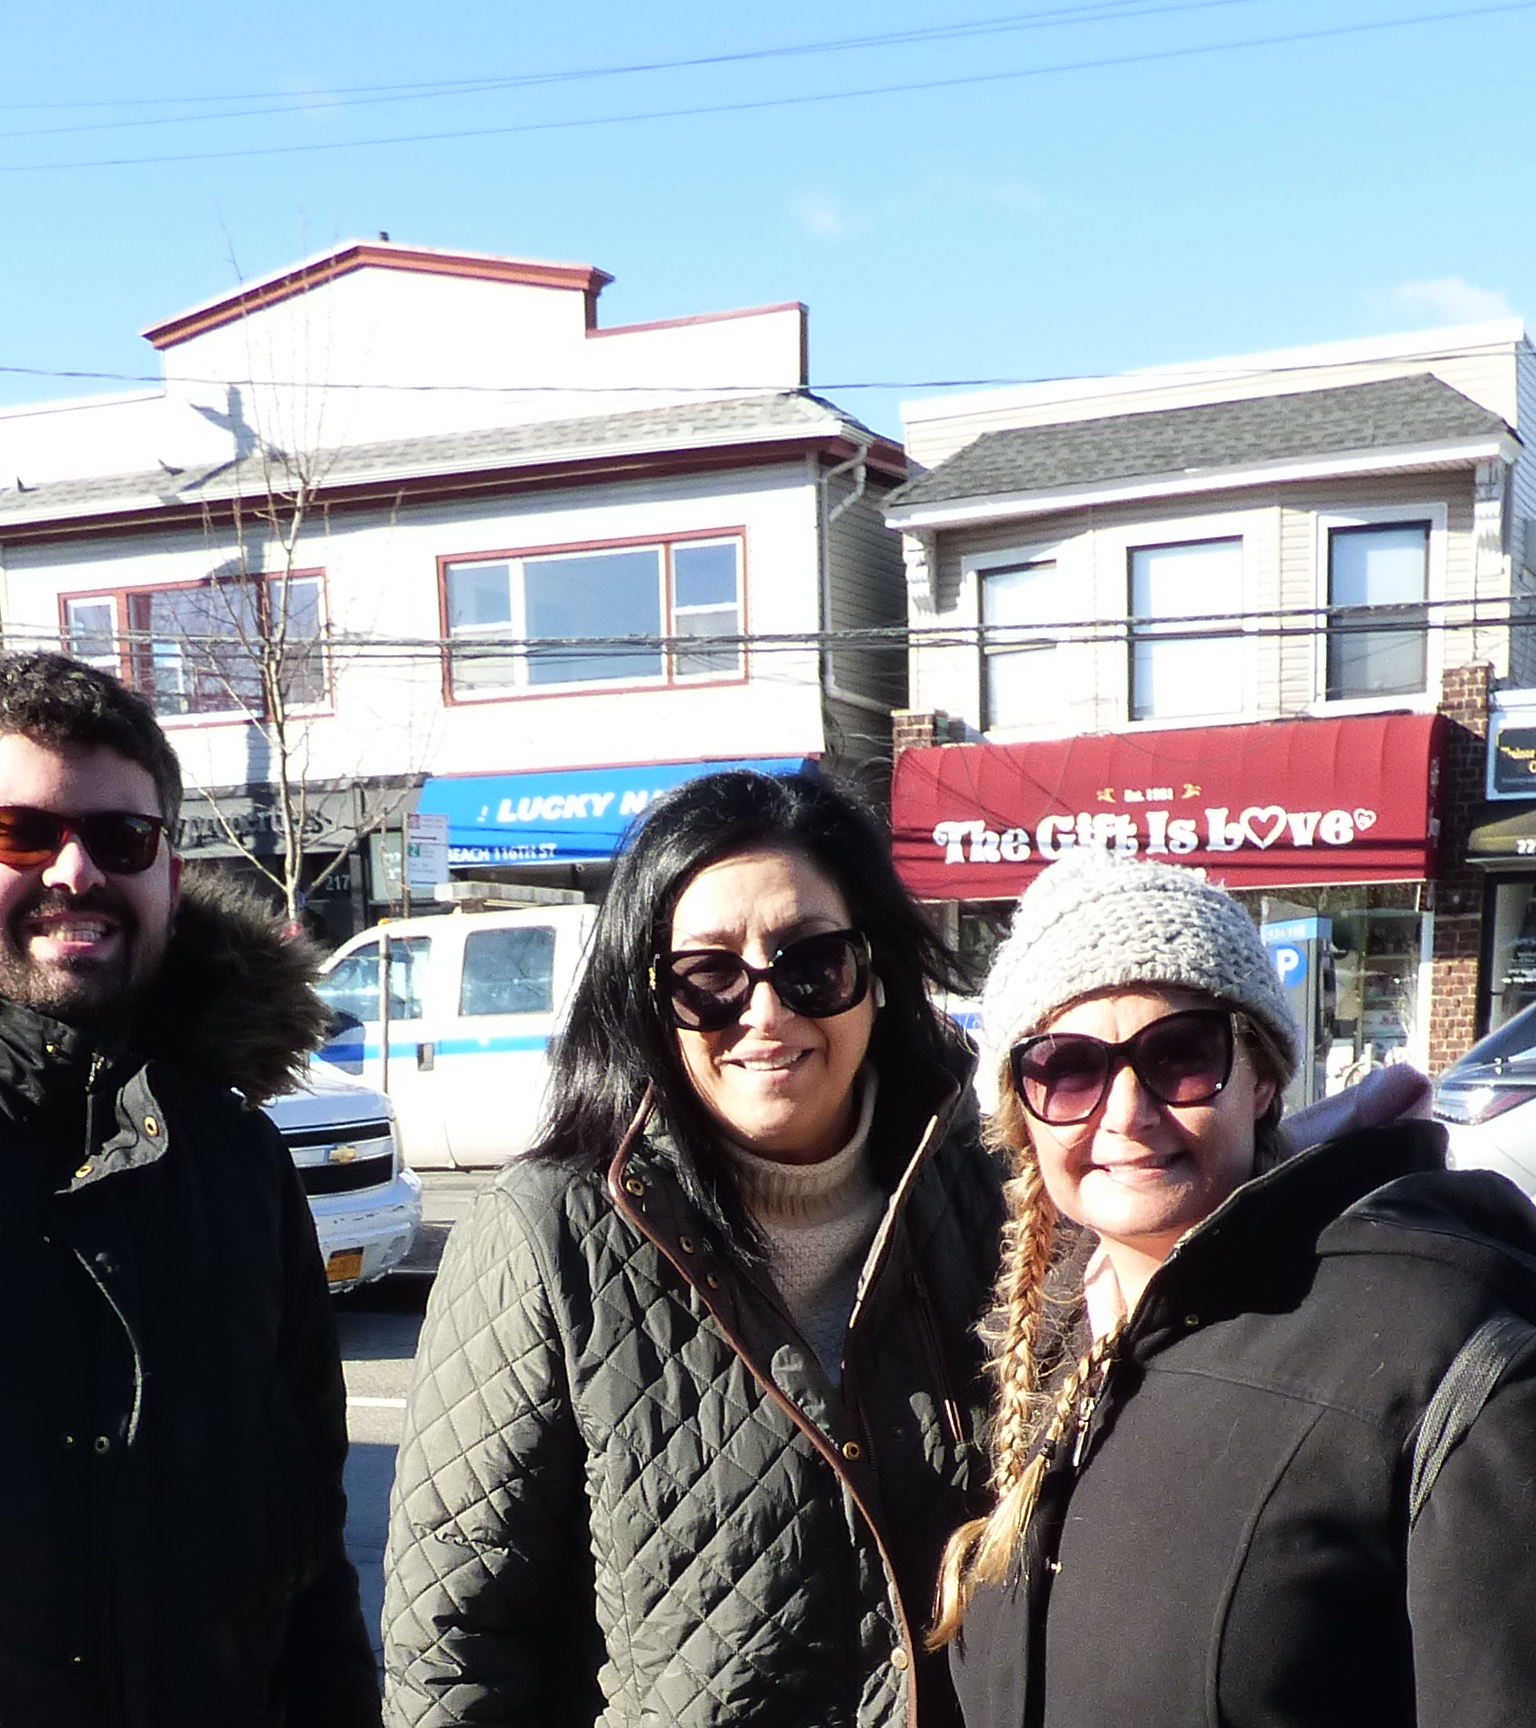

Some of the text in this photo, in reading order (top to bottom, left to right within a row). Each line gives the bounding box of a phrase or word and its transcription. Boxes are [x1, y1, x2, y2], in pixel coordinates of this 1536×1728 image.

[496, 793, 615, 822] LUCKY
[446, 847, 490, 863] BEACH
[539, 842, 557, 858] ST
[933, 820, 1031, 865] The
[1036, 811, 1139, 859] Gift
[1145, 811, 1199, 854] Is
[325, 874, 350, 891] 217
[1276, 948, 1299, 982] P
